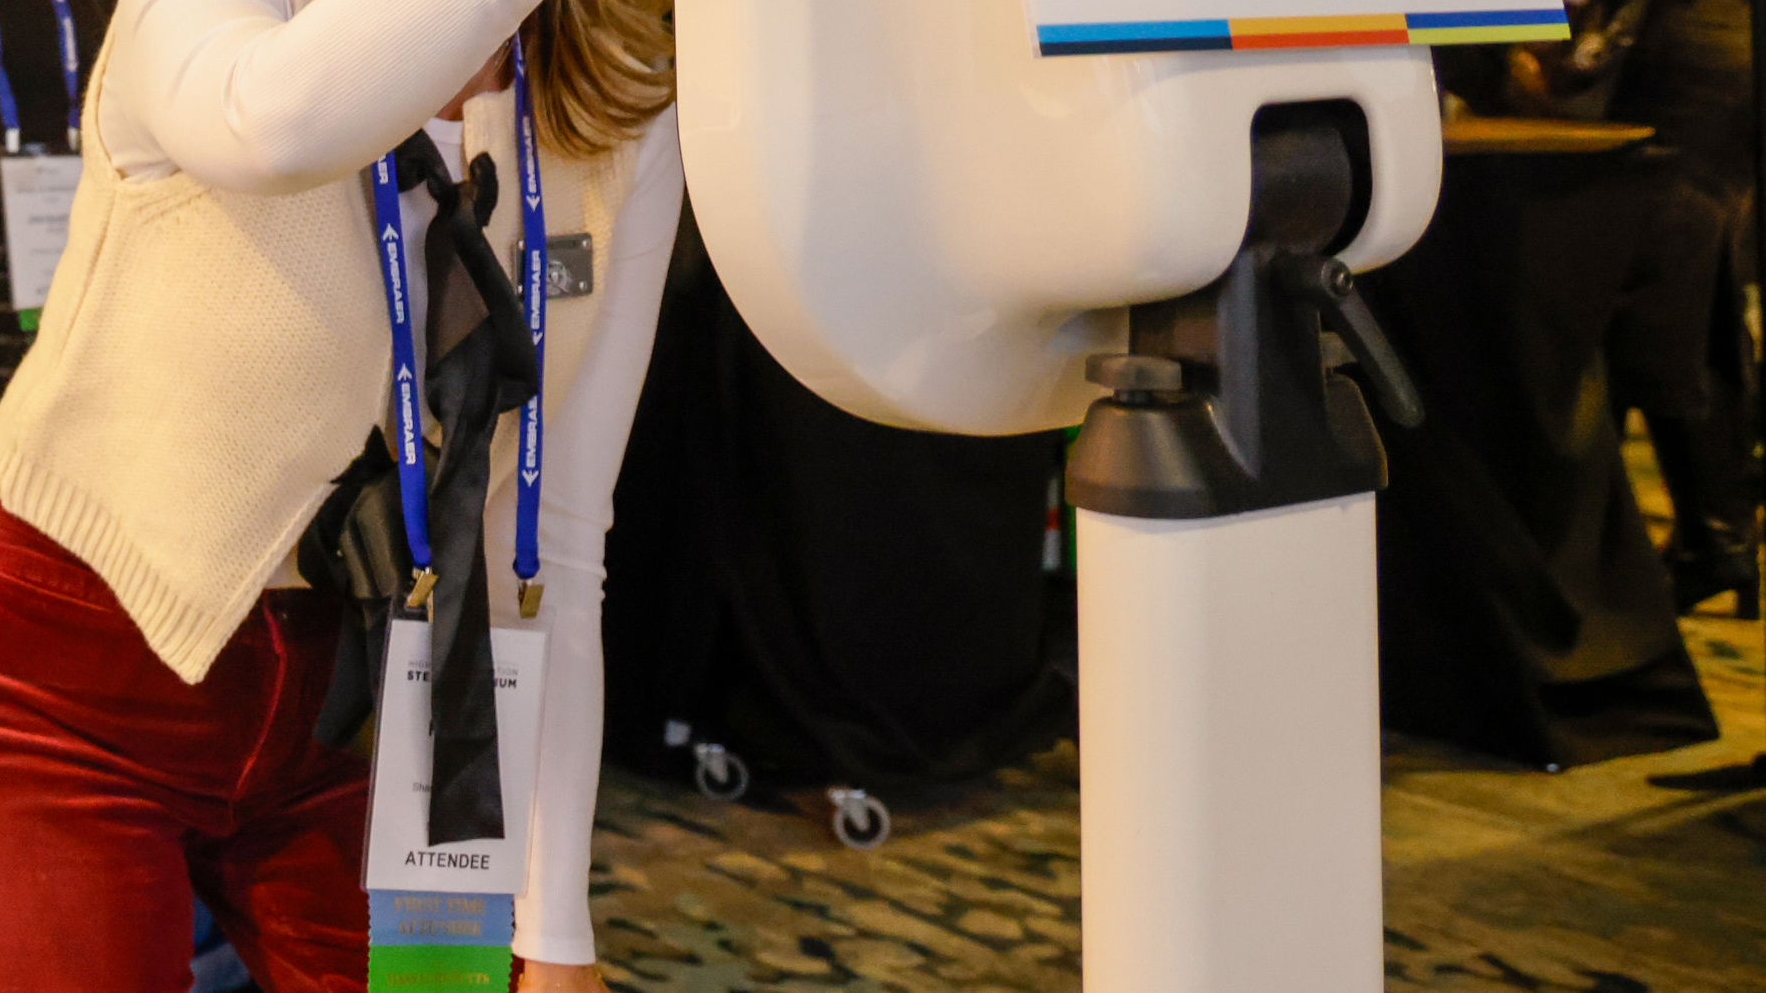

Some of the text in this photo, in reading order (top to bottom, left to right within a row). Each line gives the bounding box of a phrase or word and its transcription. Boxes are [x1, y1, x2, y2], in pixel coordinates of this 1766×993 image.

[522, 116, 537, 194] EMBRAER
[387, 242, 405, 324] EMBRAER
[531, 250, 542, 330] EMBRAER
[401, 382, 417, 465] EMBRAER
[407, 670, 431, 682] STE
[405, 851, 490, 870] ATTENDEE
[398, 919, 483, 937] ATTENDEE
